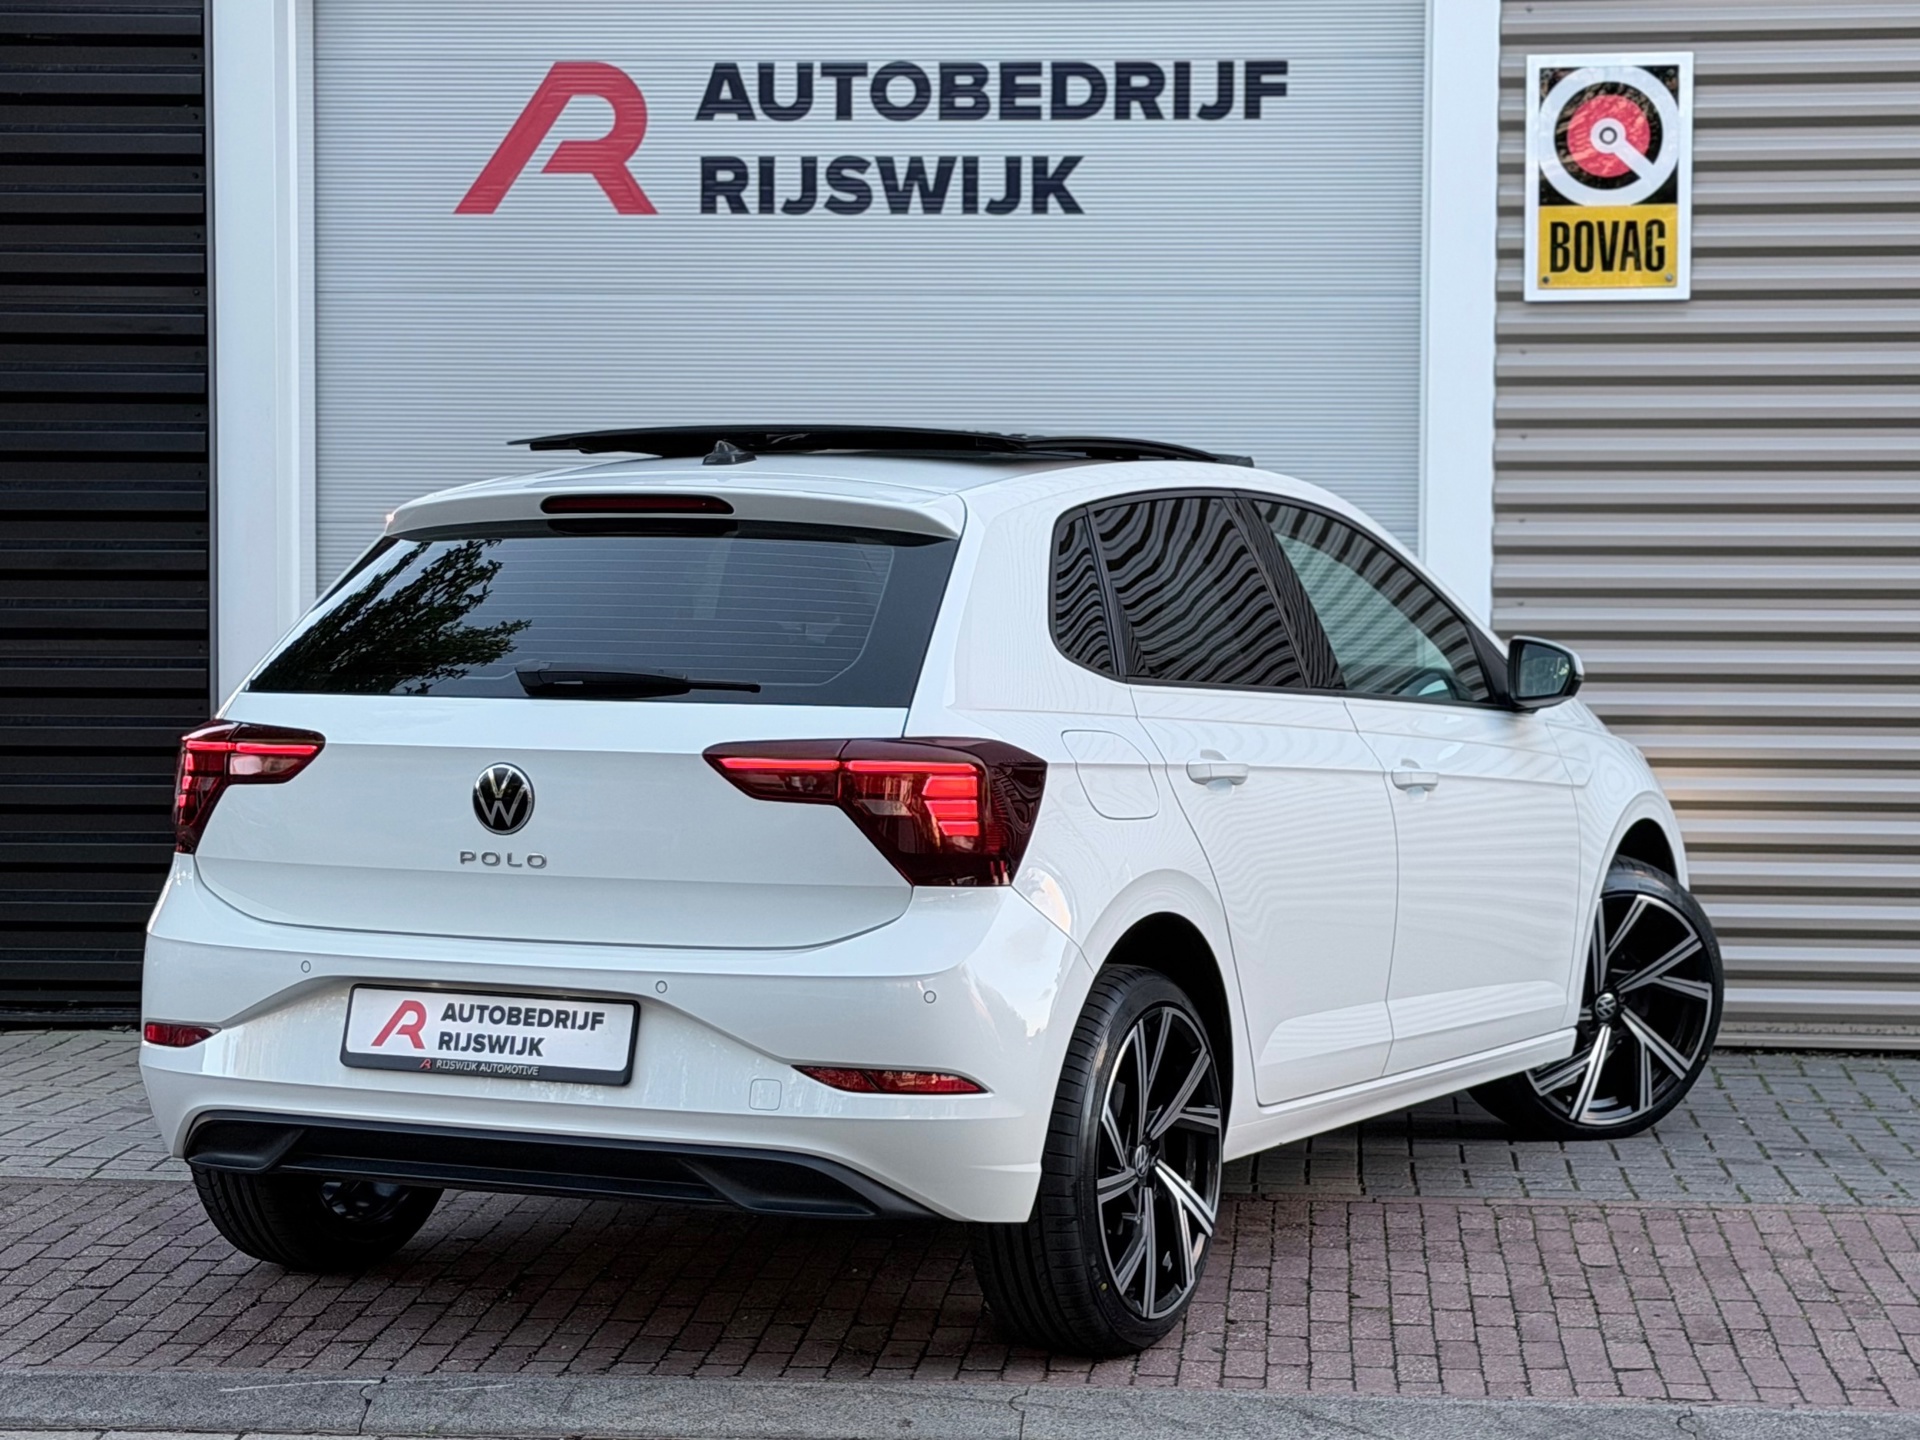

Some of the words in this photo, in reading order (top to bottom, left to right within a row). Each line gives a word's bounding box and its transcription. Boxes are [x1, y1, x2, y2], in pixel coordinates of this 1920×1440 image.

[694, 60, 1288, 122] AUTOBEDRIJF
[700, 156, 1085, 215] RIJSWIJK
[1550, 219, 1665, 272] BOVAG
[460, 850, 548, 869] POLO
[440, 1002, 605, 1031] AUTOBEDRIJF
[437, 1031, 545, 1058] RIJSWIJK
[436, 1059, 478, 1072] RIJSWIJK
[479, 1063, 539, 1075] AUTOMOTIVE
